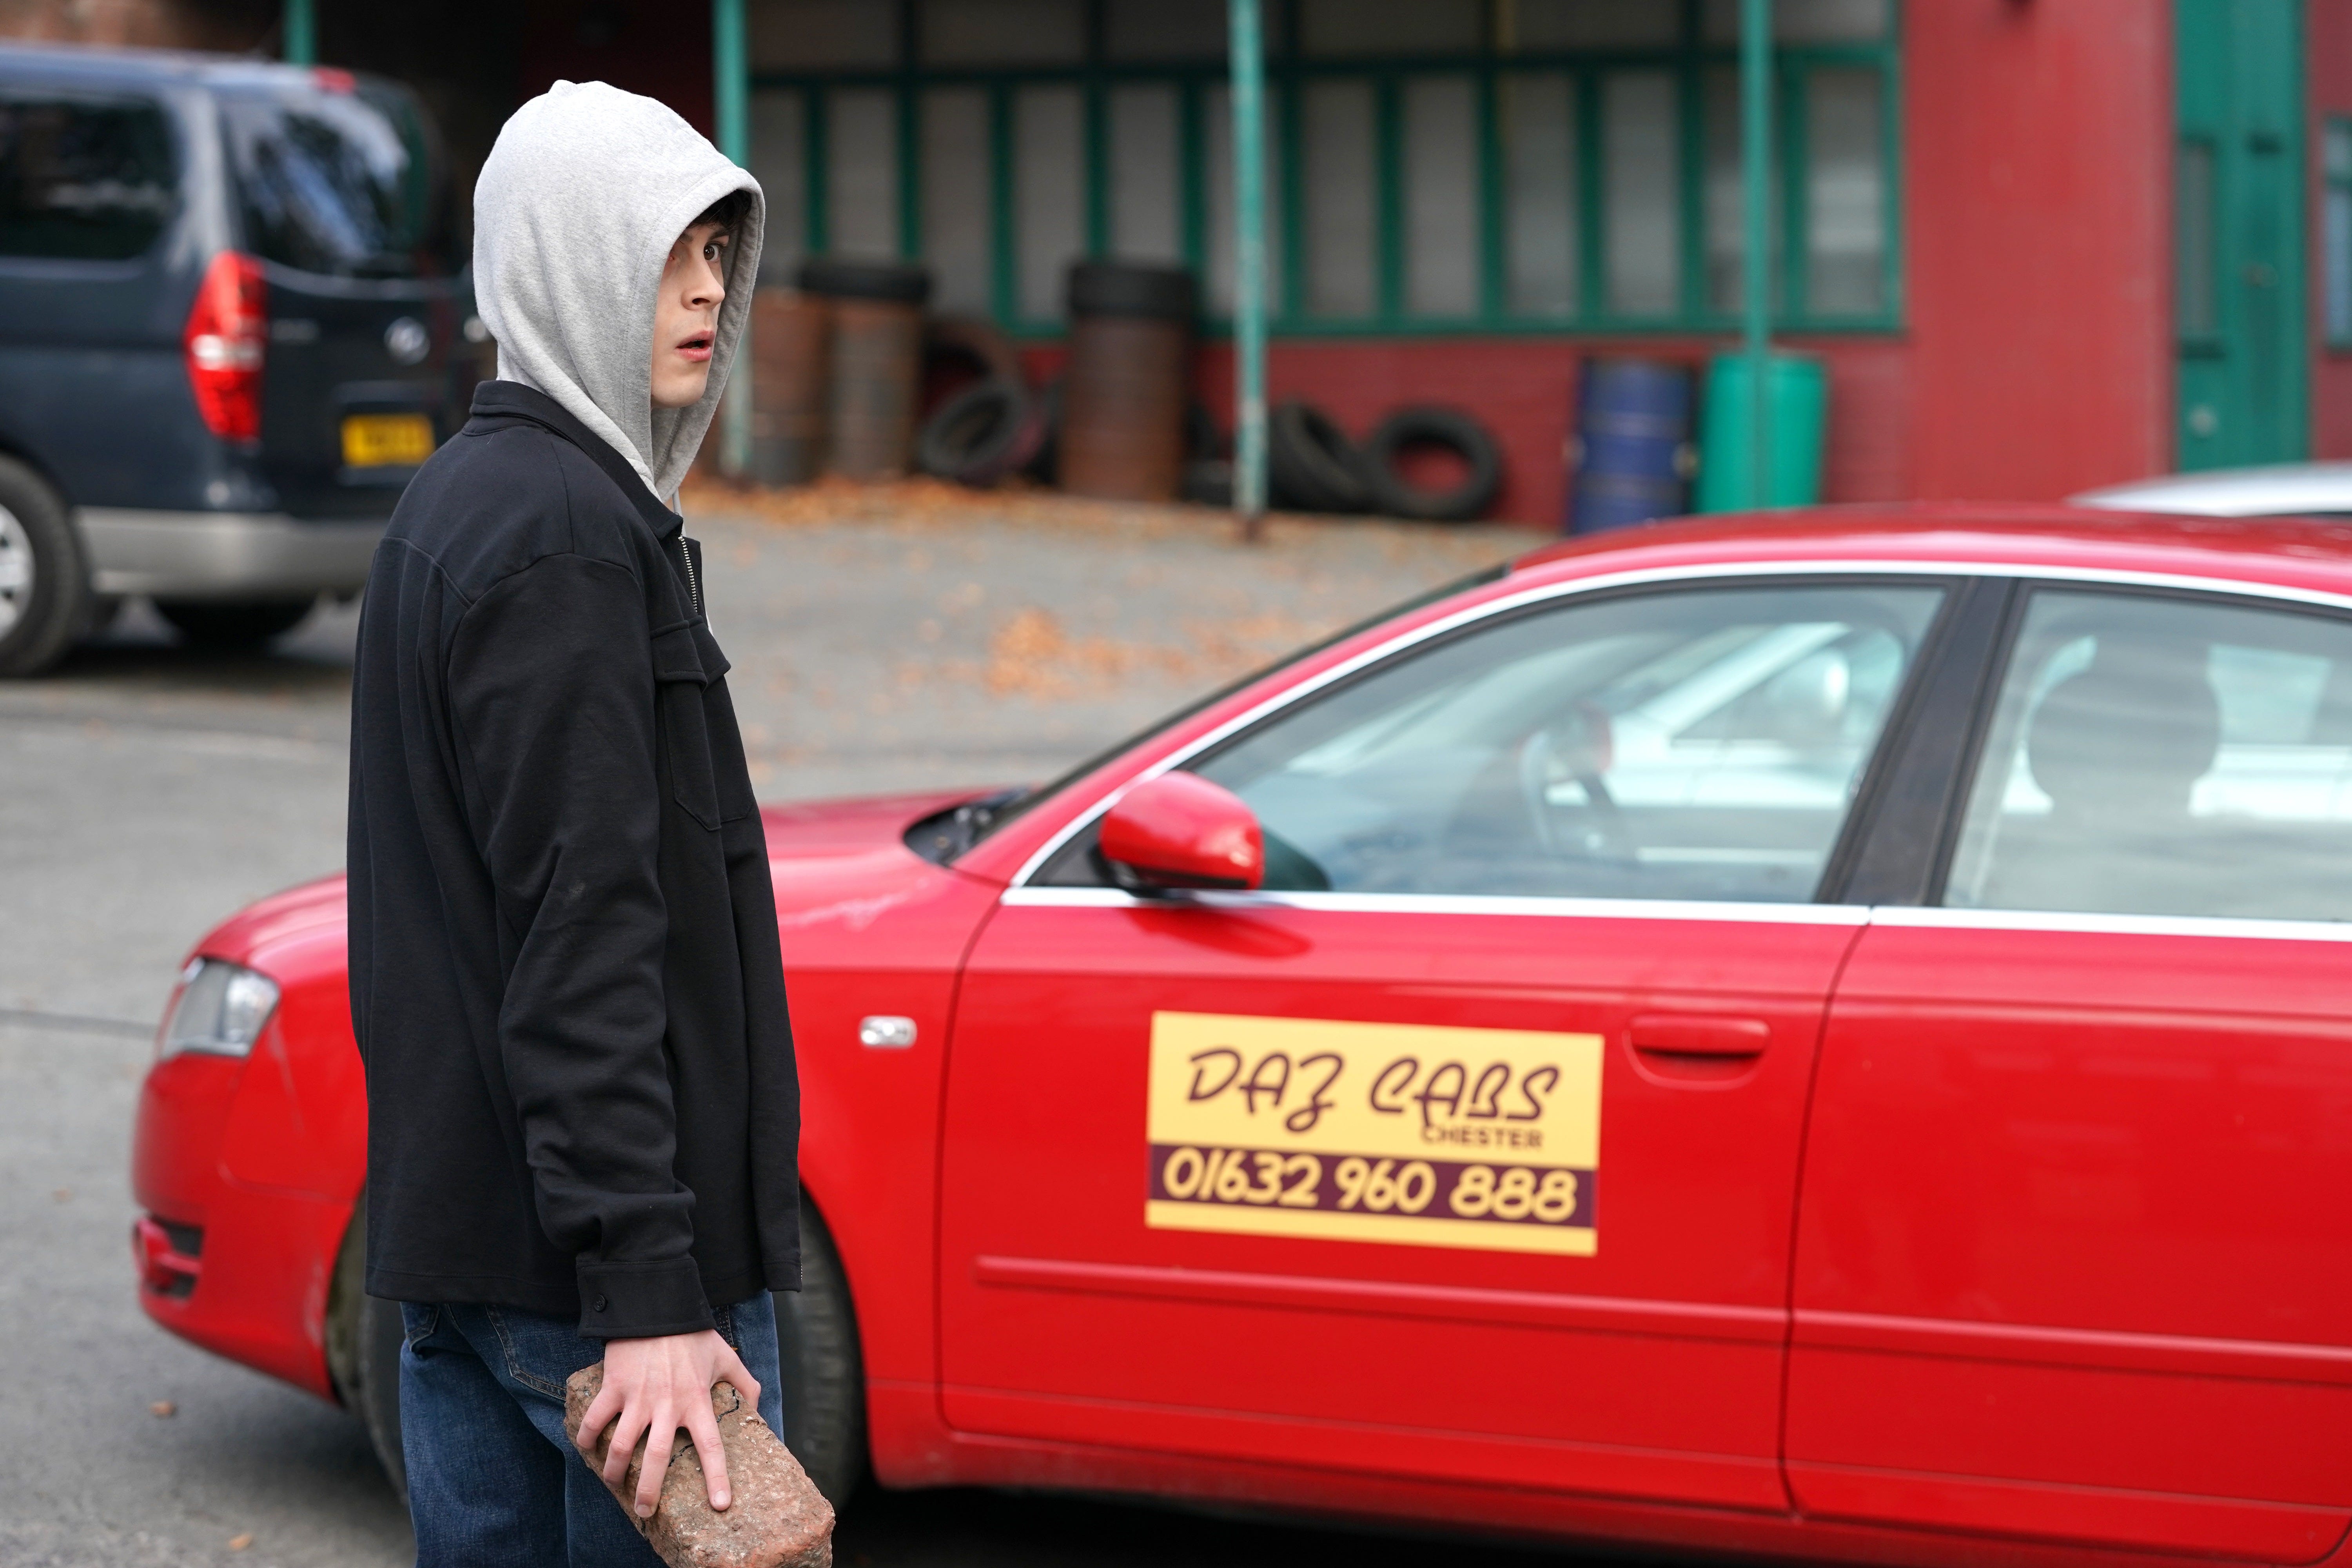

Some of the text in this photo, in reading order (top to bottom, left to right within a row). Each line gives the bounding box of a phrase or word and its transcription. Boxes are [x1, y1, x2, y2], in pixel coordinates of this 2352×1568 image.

[1186, 1047, 1561, 1134] DAZ CABS
[1421, 1125, 1543, 1150] CHESTER
[1163, 1146, 1578, 1222] 01632 960 888
